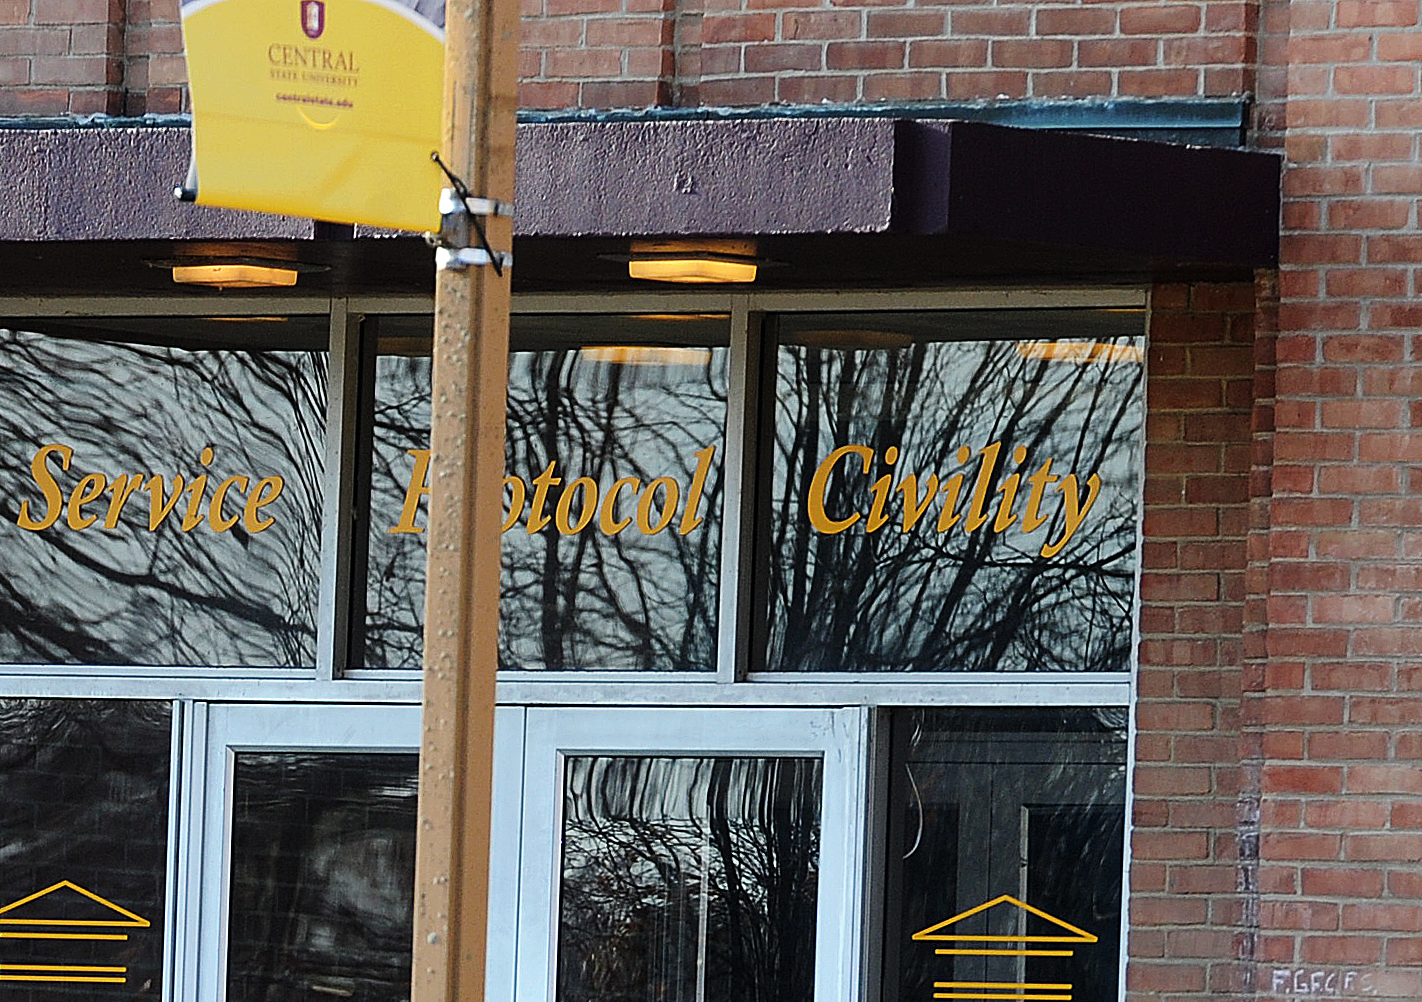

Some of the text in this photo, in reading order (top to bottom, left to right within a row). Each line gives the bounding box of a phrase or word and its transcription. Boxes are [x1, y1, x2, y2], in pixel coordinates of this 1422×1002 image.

[268, 43, 360, 72] CENTRAL
[18, 444, 283, 533] Service
[388, 447, 715, 536] Potocol
[807, 441, 1101, 558] Civility
